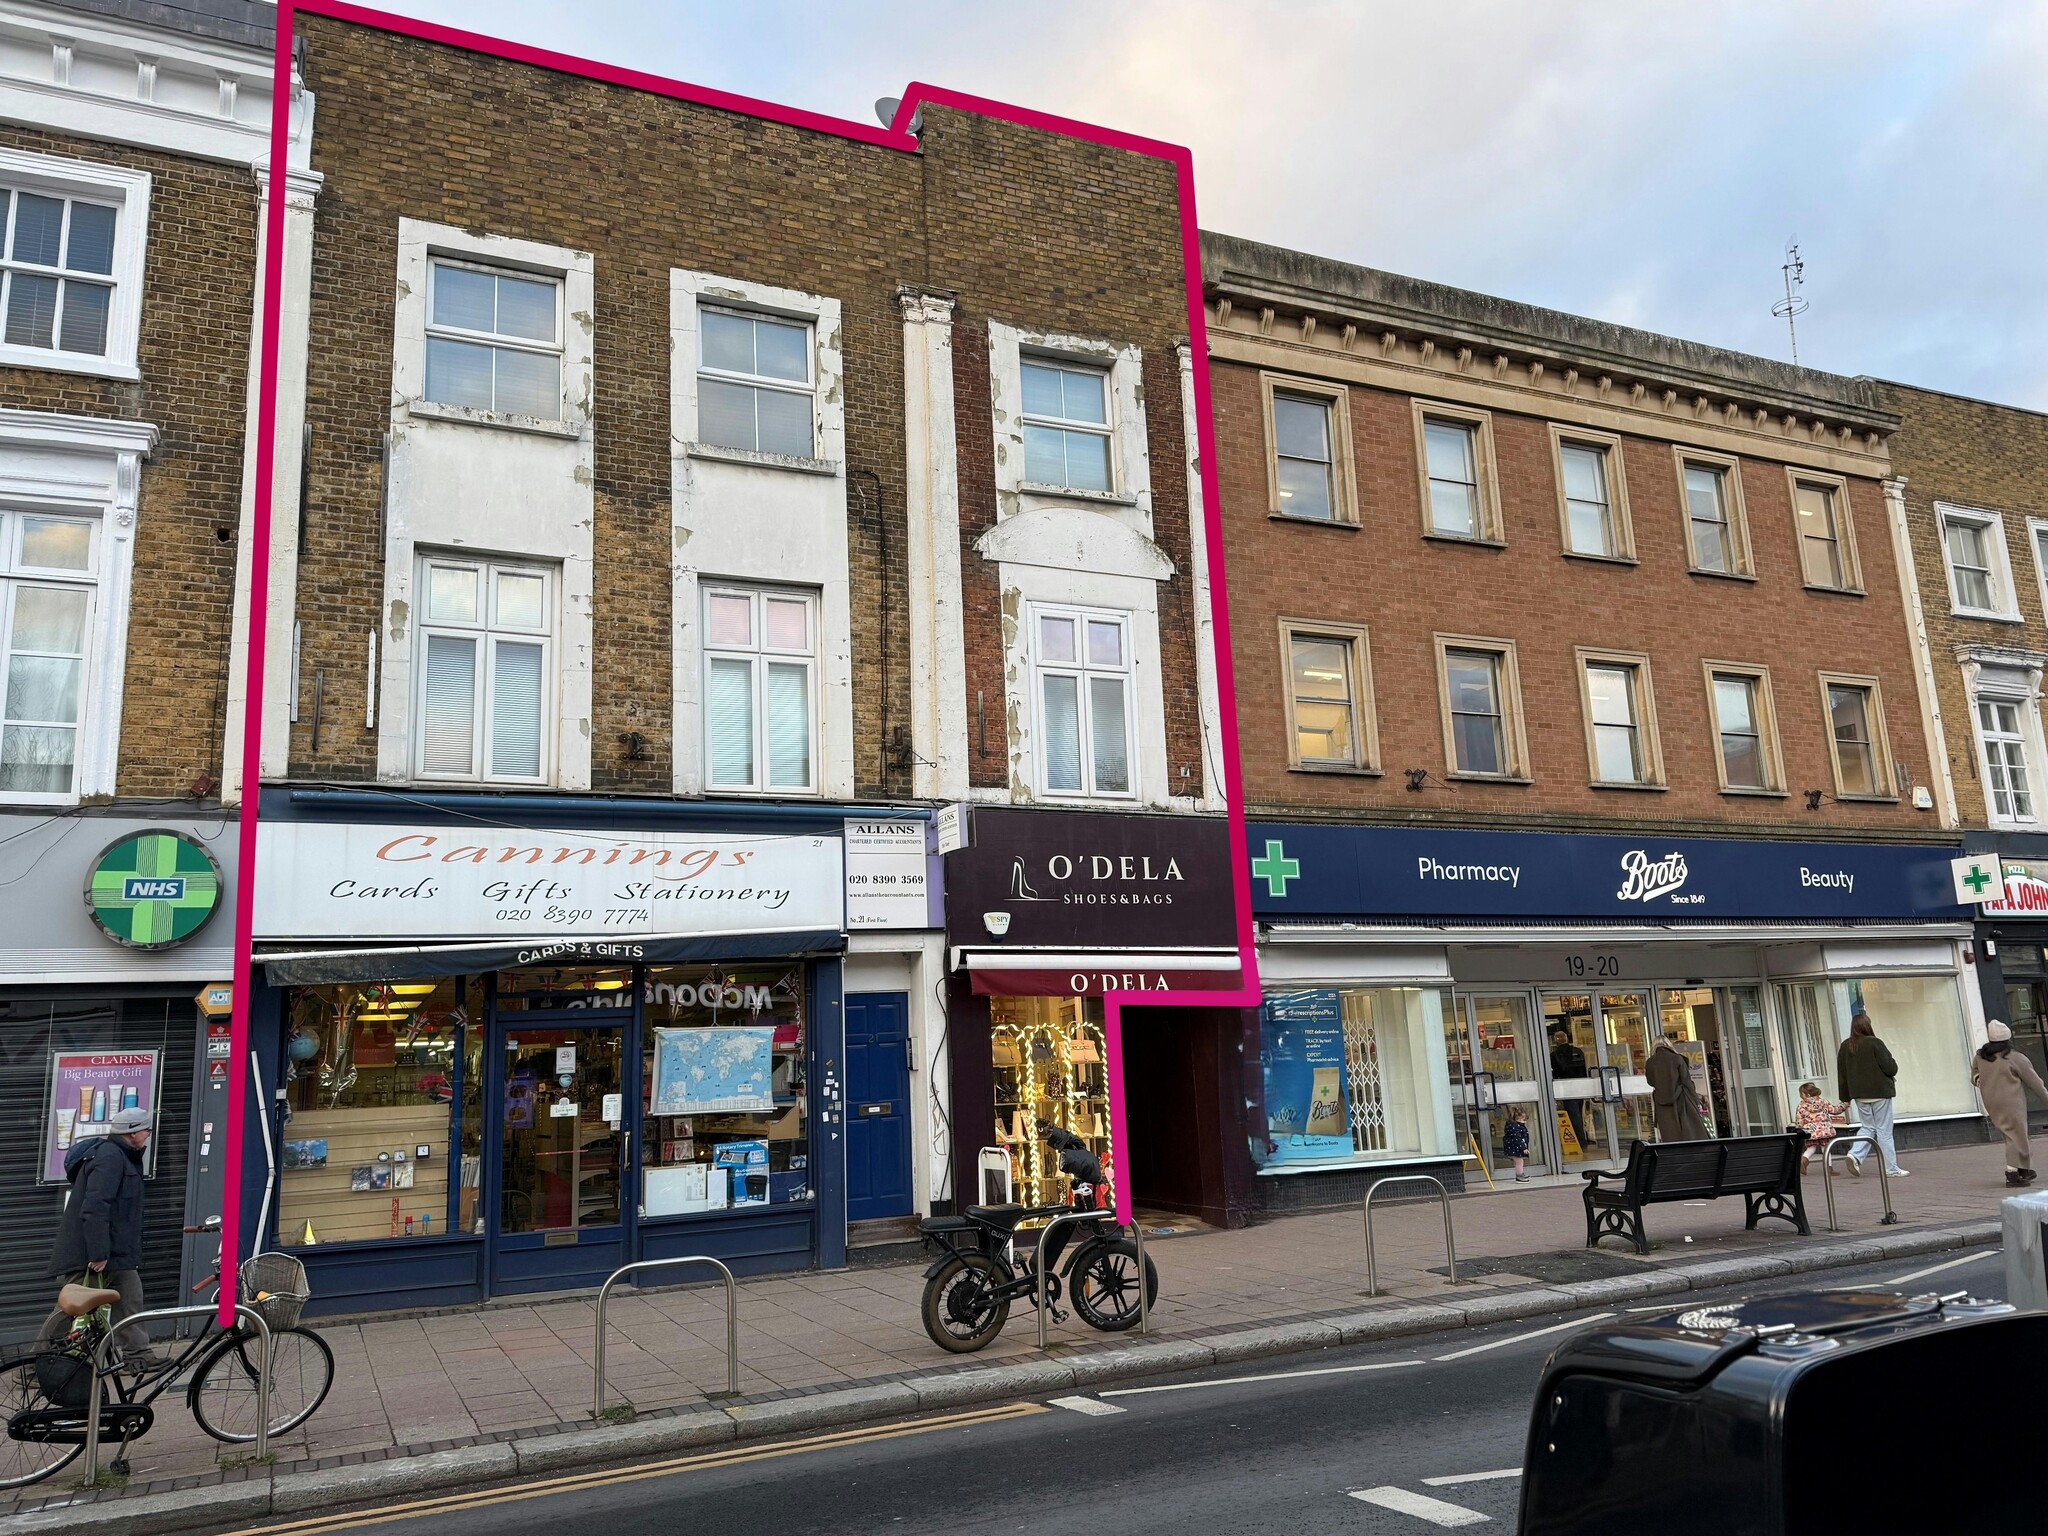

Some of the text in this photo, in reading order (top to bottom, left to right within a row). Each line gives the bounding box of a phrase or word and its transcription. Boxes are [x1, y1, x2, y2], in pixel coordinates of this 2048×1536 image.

[856, 825, 915, 835] ALLANS
[376, 835, 754, 882] Cannings
[1048, 855, 1185, 881] O'DELA
[849, 875, 924, 884] 020 8390 3569
[1418, 857, 1520, 888] Pharmacy
[1617, 850, 1688, 902] Boots
[2007, 865, 2026, 875] PIZZA
[130, 882, 179, 896] NHS
[1800, 867, 1854, 893] Beauty
[330, 877, 790, 910] Cards Gifts Stationery
[1671, 894, 1705, 904] Since 1849
[496, 905, 649, 925] 020 8390 7774
[518, 940, 644, 964] CARDS & GIFTS
[1070, 973, 1170, 992] O'DELA
[209, 992, 231, 1002] ADT
[91, 1055, 152, 1065] CLARINS
[64, 1067, 142, 1081] Big Beauty Gift
